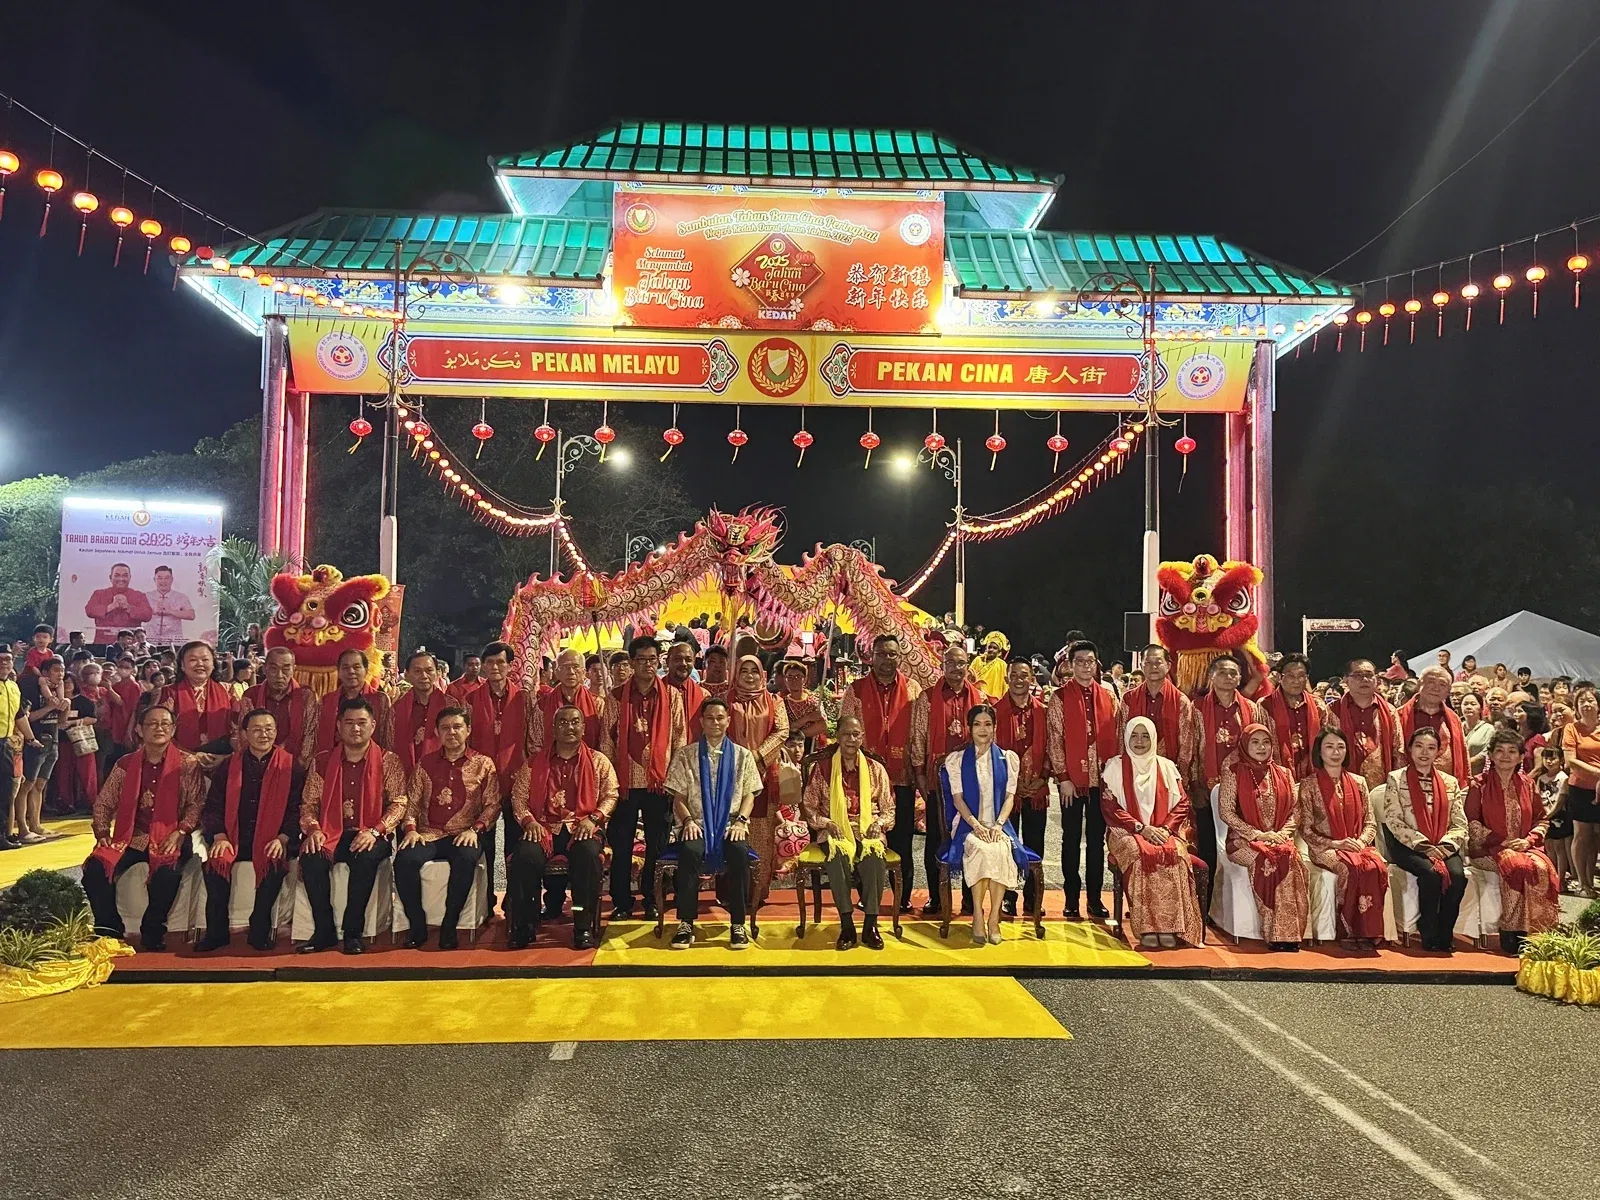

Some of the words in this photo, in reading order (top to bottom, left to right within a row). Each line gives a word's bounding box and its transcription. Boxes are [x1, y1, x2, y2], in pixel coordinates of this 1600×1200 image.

[677, 213, 732, 236] Sambutan
[733, 209, 769, 223] Tahun
[770, 208, 799, 222] Baru
[800, 211, 825, 227] Cina
[825, 215, 879, 242] Peringkat
[705, 226, 731, 239] Negeri
[733, 223, 757, 234] Kedah
[782, 223, 806, 234] Aman
[807, 226, 831, 238] Tahun
[644, 247, 685, 259] Selamat
[754, 253, 790, 269] 2025
[636, 259, 693, 275] Menyambut
[764, 266, 802, 281] Tahun
[846, 262, 931, 287] 恭贺新禧
[637, 271, 691, 294] Tahun
[749, 277, 779, 291] Baru
[779, 279, 806, 292] Cina
[623, 286, 667, 307] Baru
[665, 290, 704, 310] Cina
[845, 286, 929, 310] 新年快乐
[757, 309, 796, 320] KEDAH
[531, 351, 597, 373] PEKAN
[602, 354, 680, 375] MELAYU
[877, 361, 953, 383] PEKAN
[960, 363, 1014, 383] CINA
[1024, 364, 1108, 385] 唐人街
[65, 534, 88, 543] TAHUN
[90, 535, 119, 544] BAHARU
[121, 536, 137, 545] CINA
[138, 532, 172, 547] 2025
